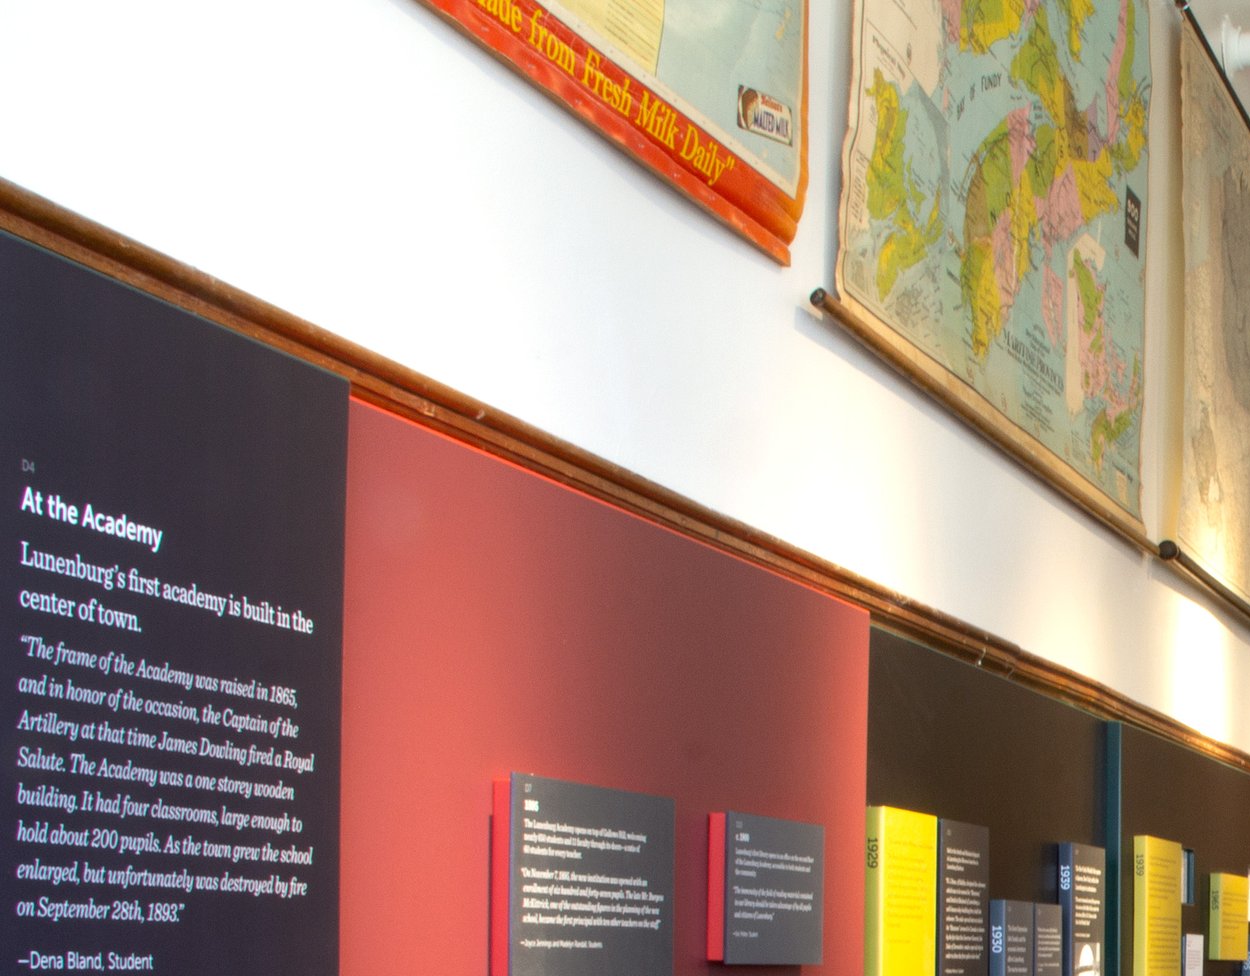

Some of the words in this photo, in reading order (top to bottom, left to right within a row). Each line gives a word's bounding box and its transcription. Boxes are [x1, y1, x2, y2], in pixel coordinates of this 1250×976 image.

[476, 0, 523, 32] ade
[529, 9, 576, 76] from
[581, 47, 633, 117] Fresh
[635, 90, 679, 150] Milk
[21, 487, 43, 515] At
[47, 495, 78, 524] the
[82, 504, 162, 551] Academy
[20, 590, 75, 617] center
[78, 600, 97, 622] of
[98, 604, 141, 632] town.
[128, 568, 160, 597] first
[163, 584, 227, 616] academy
[229, 594, 241, 616] is
[243, 596, 275, 625] built
[277, 606, 290, 629] in
[292, 610, 313, 634] the
[53, 642, 97, 668] frame
[99, 652, 113, 675] of
[113, 652, 134, 675] the
[135, 659, 193, 690] Academy
[195, 675, 218, 691] was
[220, 678, 255, 698] raised
[257, 683, 268, 701] in
[270, 686, 297, 708] 1865,
[18, 677, 47, 695] and
[49, 678, 63, 698] in
[66, 681, 106, 705] honor
[108, 689, 123, 712] of
[123, 691, 143, 712] the
[145, 700, 199, 723] occasion,
[202, 704, 221, 725] the
[223, 708, 268, 733] Captain
[269, 717, 282, 738] of
[282, 718, 299, 738] the
[17, 711, 79, 741] Artillery
[81, 723, 96, 739] at
[98, 722, 125, 744] that
[127, 728, 156, 748] time
[158, 731, 198, 755] James
[199, 737, 247, 765] Dowling
[247, 745, 274, 766] fired
[274, 754, 282, 767] a
[283, 750, 314, 773] Royal
[17, 747, 65, 772] Salute.
[71, 753, 96, 775] The
[97, 758, 157, 787] Academy
[160, 771, 183, 786] was
[185, 774, 193, 787] a
[195, 776, 216, 790] one
[217, 776, 252, 798] storey
[254, 780, 294, 800] wooden
[18, 784, 78, 813] building.
[81, 791, 93, 811] It
[95, 792, 121, 814] had
[121, 795, 150, 818] four
[151, 798, 219, 826] classrooms,
[221, 806, 250, 830] large
[251, 813, 290, 834] enough
[292, 817, 302, 832] to
[17, 821, 48, 843] hold
[50, 824, 89, 846] about
[91, 828, 118, 849] 200
[119, 832, 161, 855] pupils.
[163, 835, 180, 854] As
[182, 836, 201, 856] the
[203, 840, 231, 858] town
[232, 846, 260, 862] grew
[262, 843, 279, 862] the
[280, 845, 313, 864] school
[867, 838, 878, 869] 1929
[17, 860, 80, 885] enlarged,
[83, 862, 106, 883] but
[108, 865, 194, 892] unfortunately
[196, 876, 219, 890] was
[220, 872, 274, 896] destroyed
[275, 876, 288, 898] by
[288, 877, 307, 898] fire
[1060, 865, 1070, 890] 1939
[17, 901, 35, 916] on
[37, 896, 110, 921] September
[112, 900, 144, 923] 28th,
[68, 951, 104, 971] Bland,
[108, 952, 153, 970] Student
[992, 925, 1003, 953] 1930
